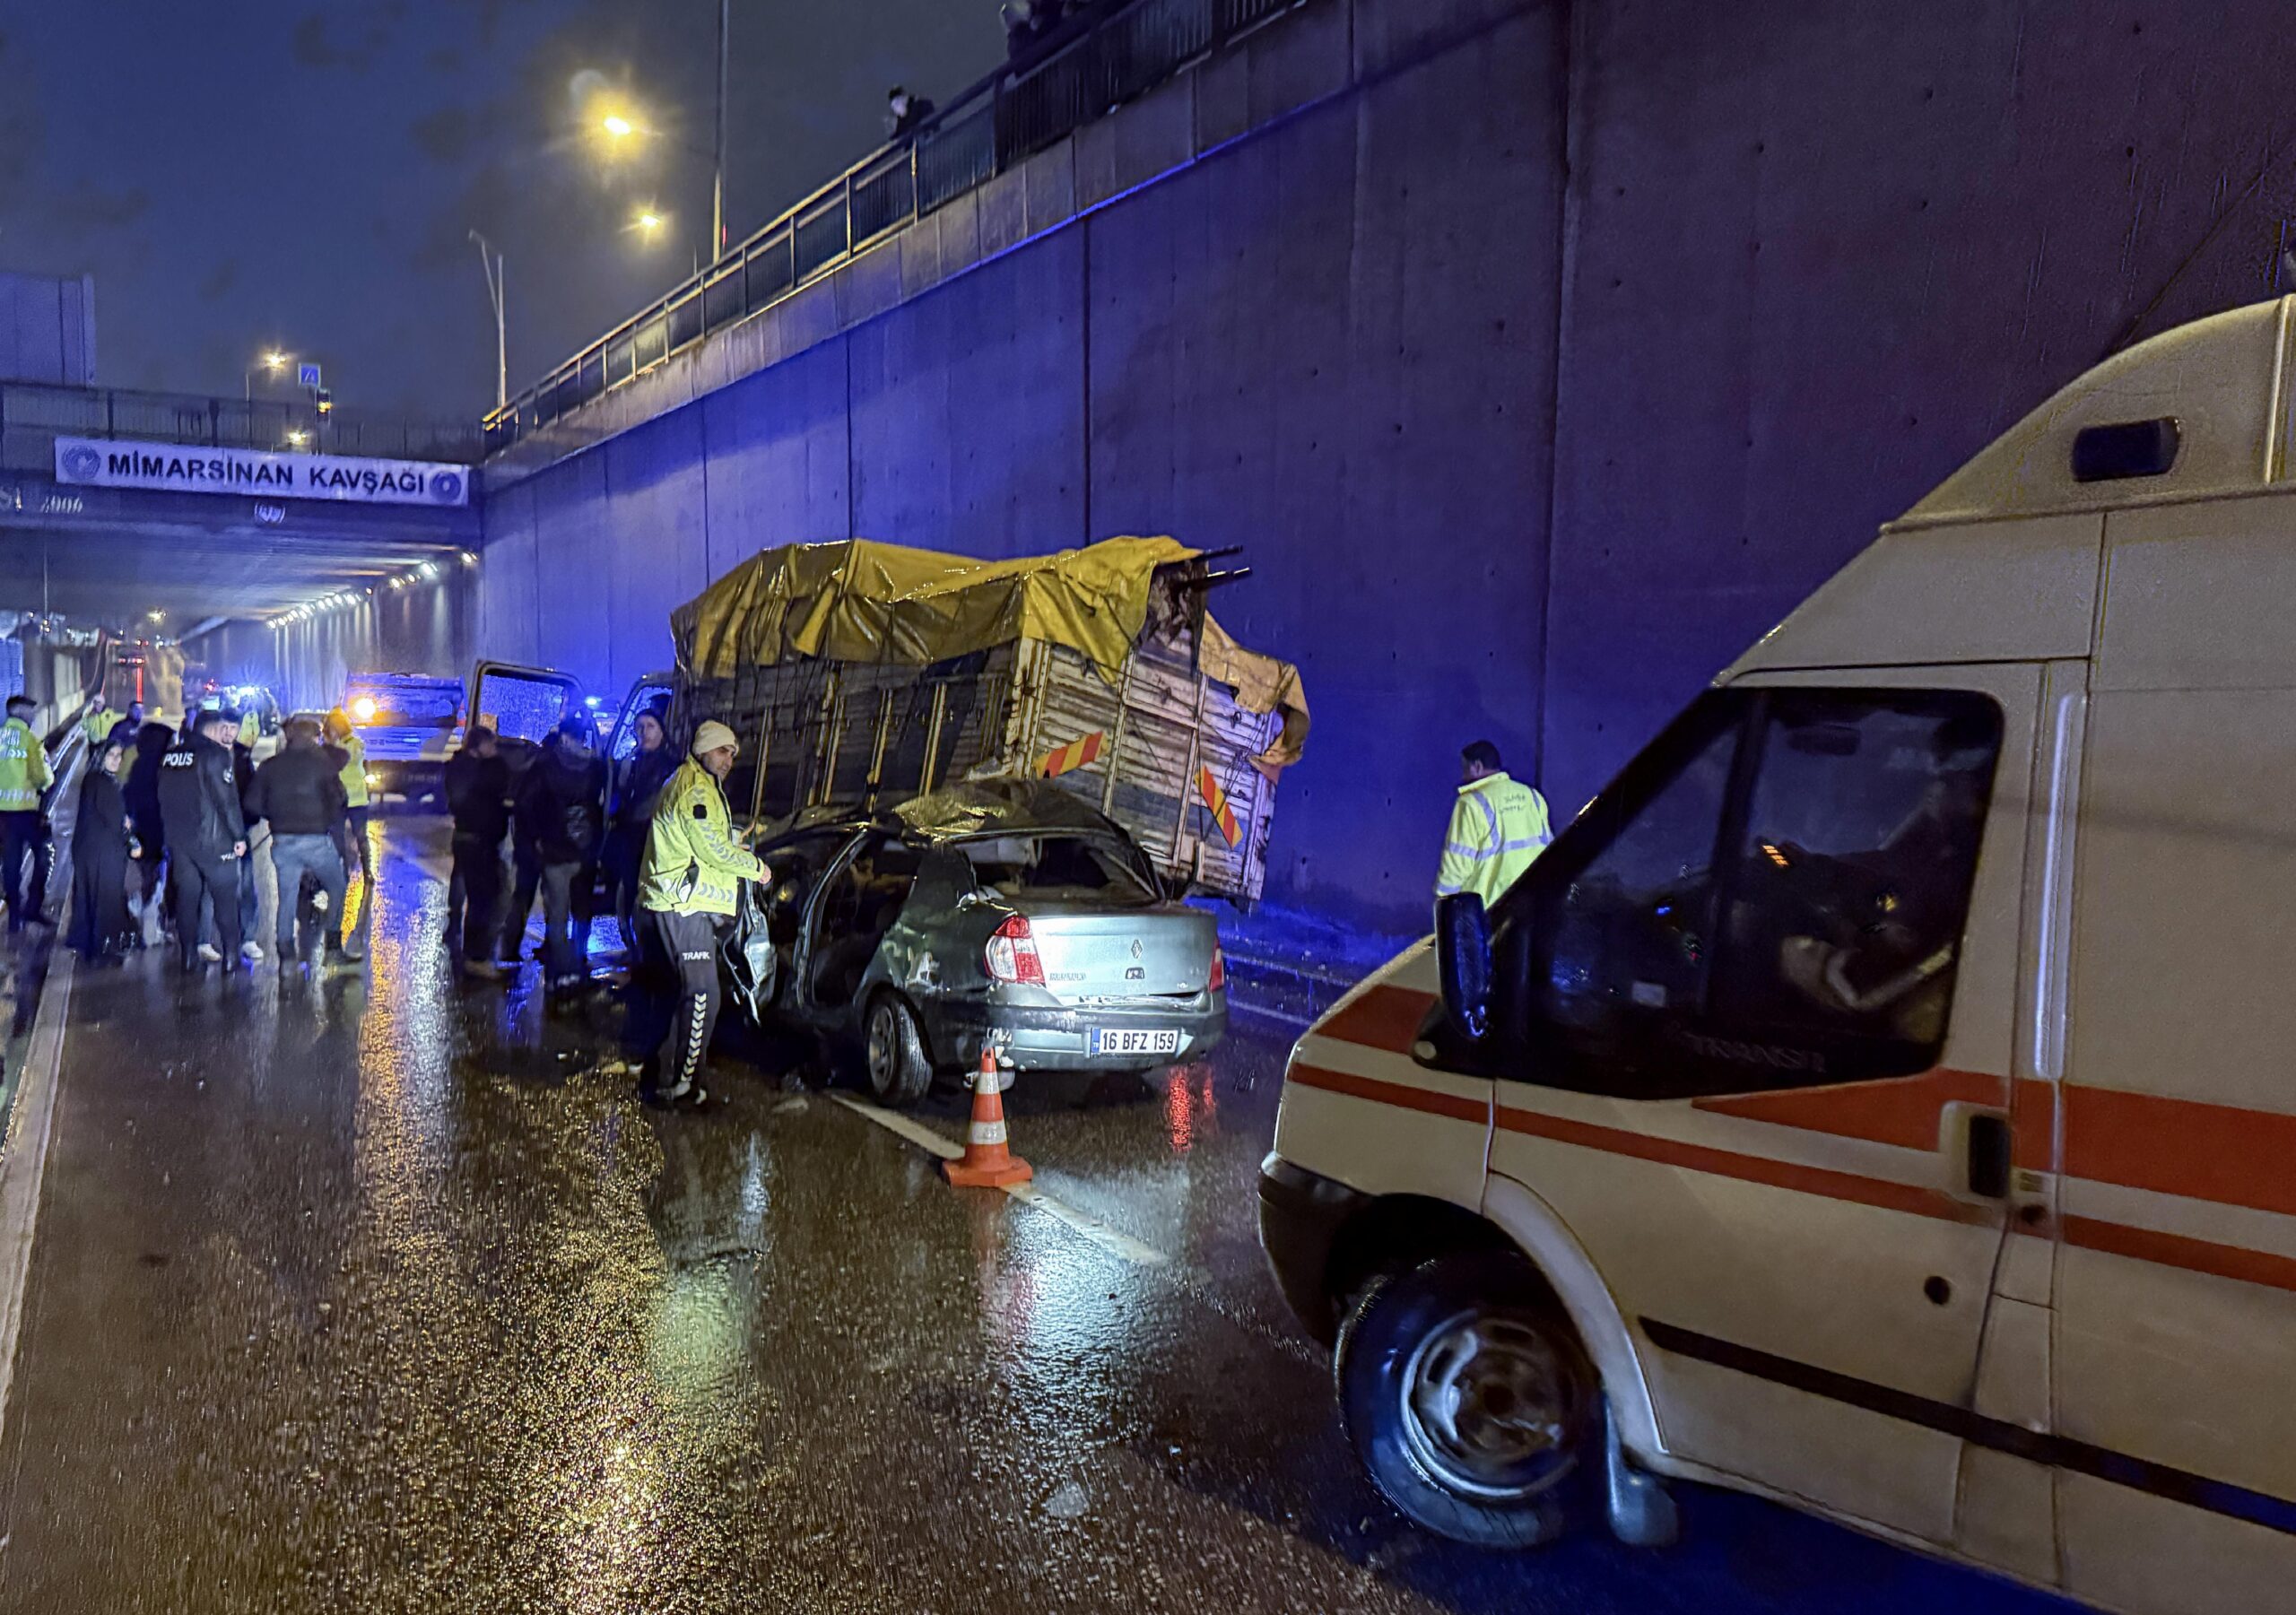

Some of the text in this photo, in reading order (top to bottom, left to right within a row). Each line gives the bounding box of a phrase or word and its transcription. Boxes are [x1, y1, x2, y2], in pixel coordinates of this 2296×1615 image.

[109, 451, 425, 495] MİMARSİNAN KAVŞAĞI
[1102, 1032, 1175, 1051] 16 BFZ 159
